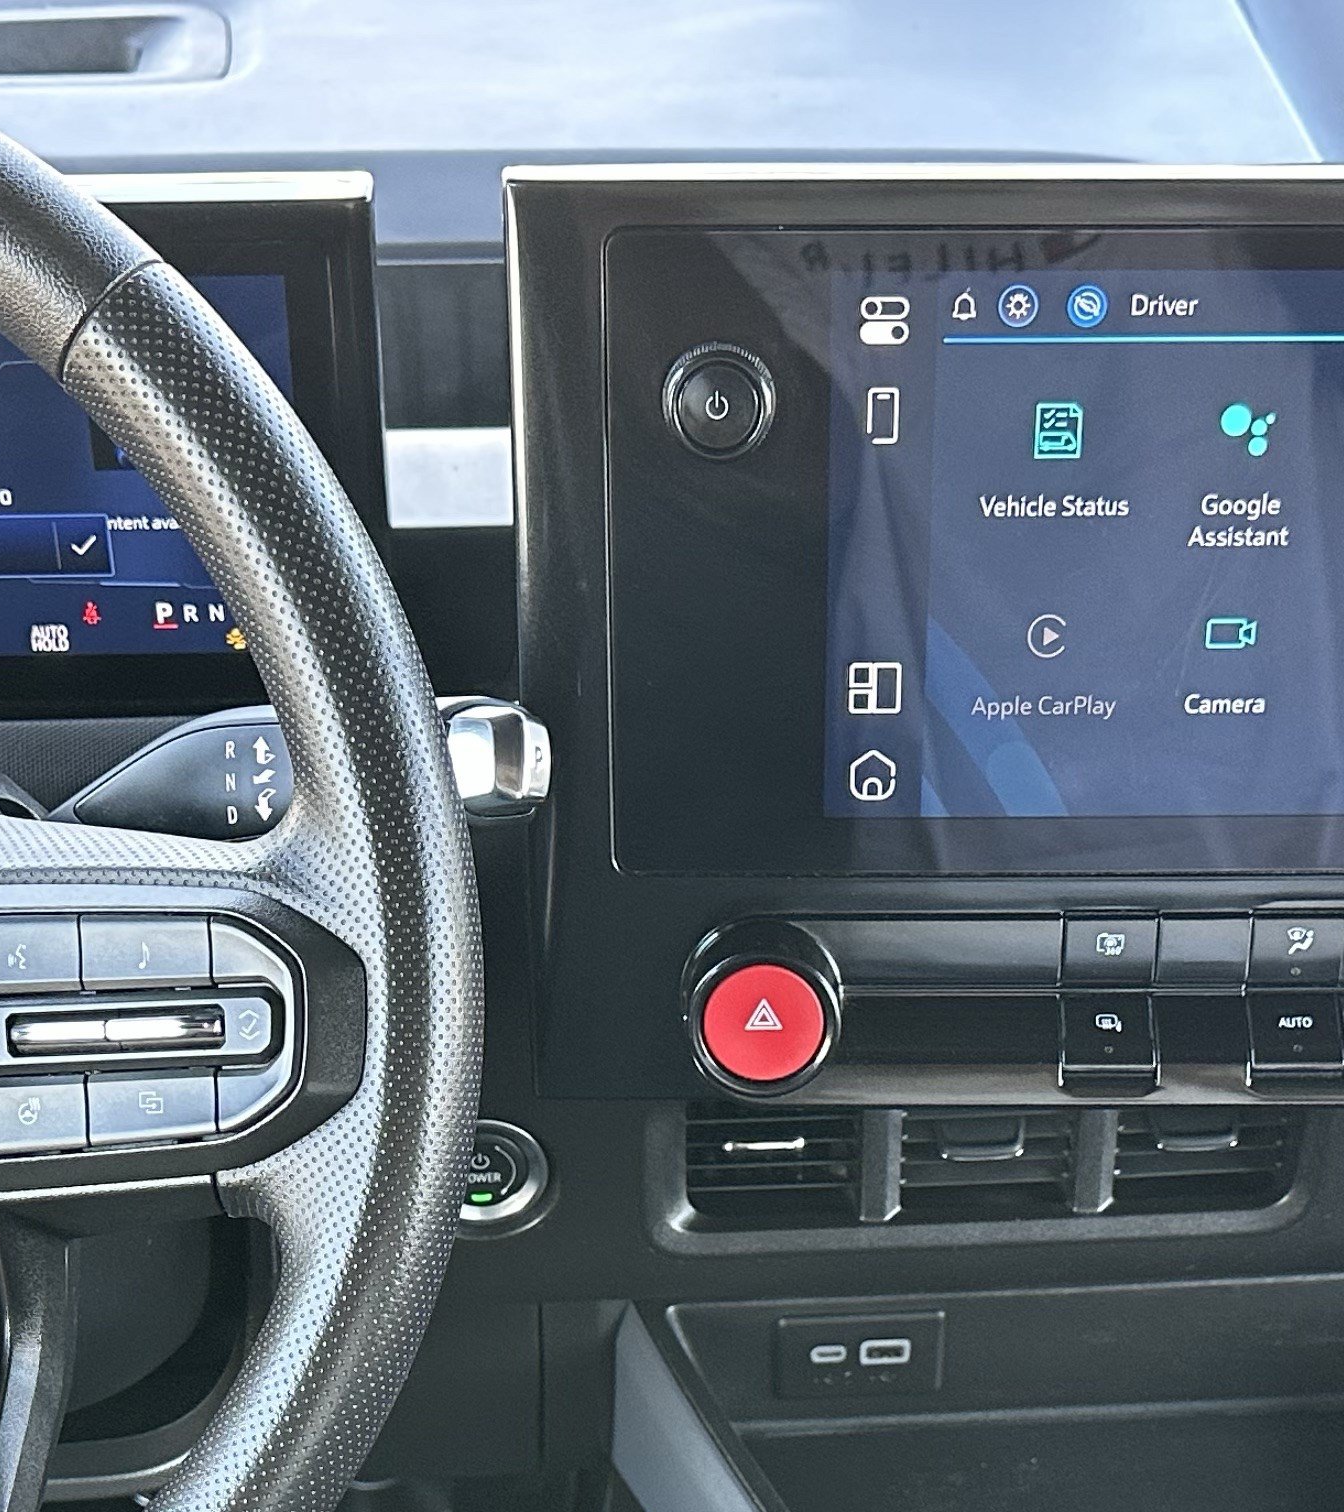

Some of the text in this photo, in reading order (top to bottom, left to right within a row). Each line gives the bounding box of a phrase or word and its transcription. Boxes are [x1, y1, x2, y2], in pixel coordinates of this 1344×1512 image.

[1131, 293, 1199, 316] Driver
[979, 493, 1130, 517] Vehicle Status
[1201, 491, 1281, 521] Google
[1187, 525, 1290, 547] Assistant
[155, 601, 225, 623] P R N
[31, 626, 67, 639] AUTO
[31, 639, 70, 651] HOLD
[971, 694, 1117, 721] Apple CarPlay
[1184, 693, 1266, 714] Camera
[225, 740, 236, 760] R
[225, 772, 236, 792] N
[226, 805, 238, 825] D
[1278, 1016, 1313, 1028] AUTO
[468, 1171, 502, 1183] OWER
